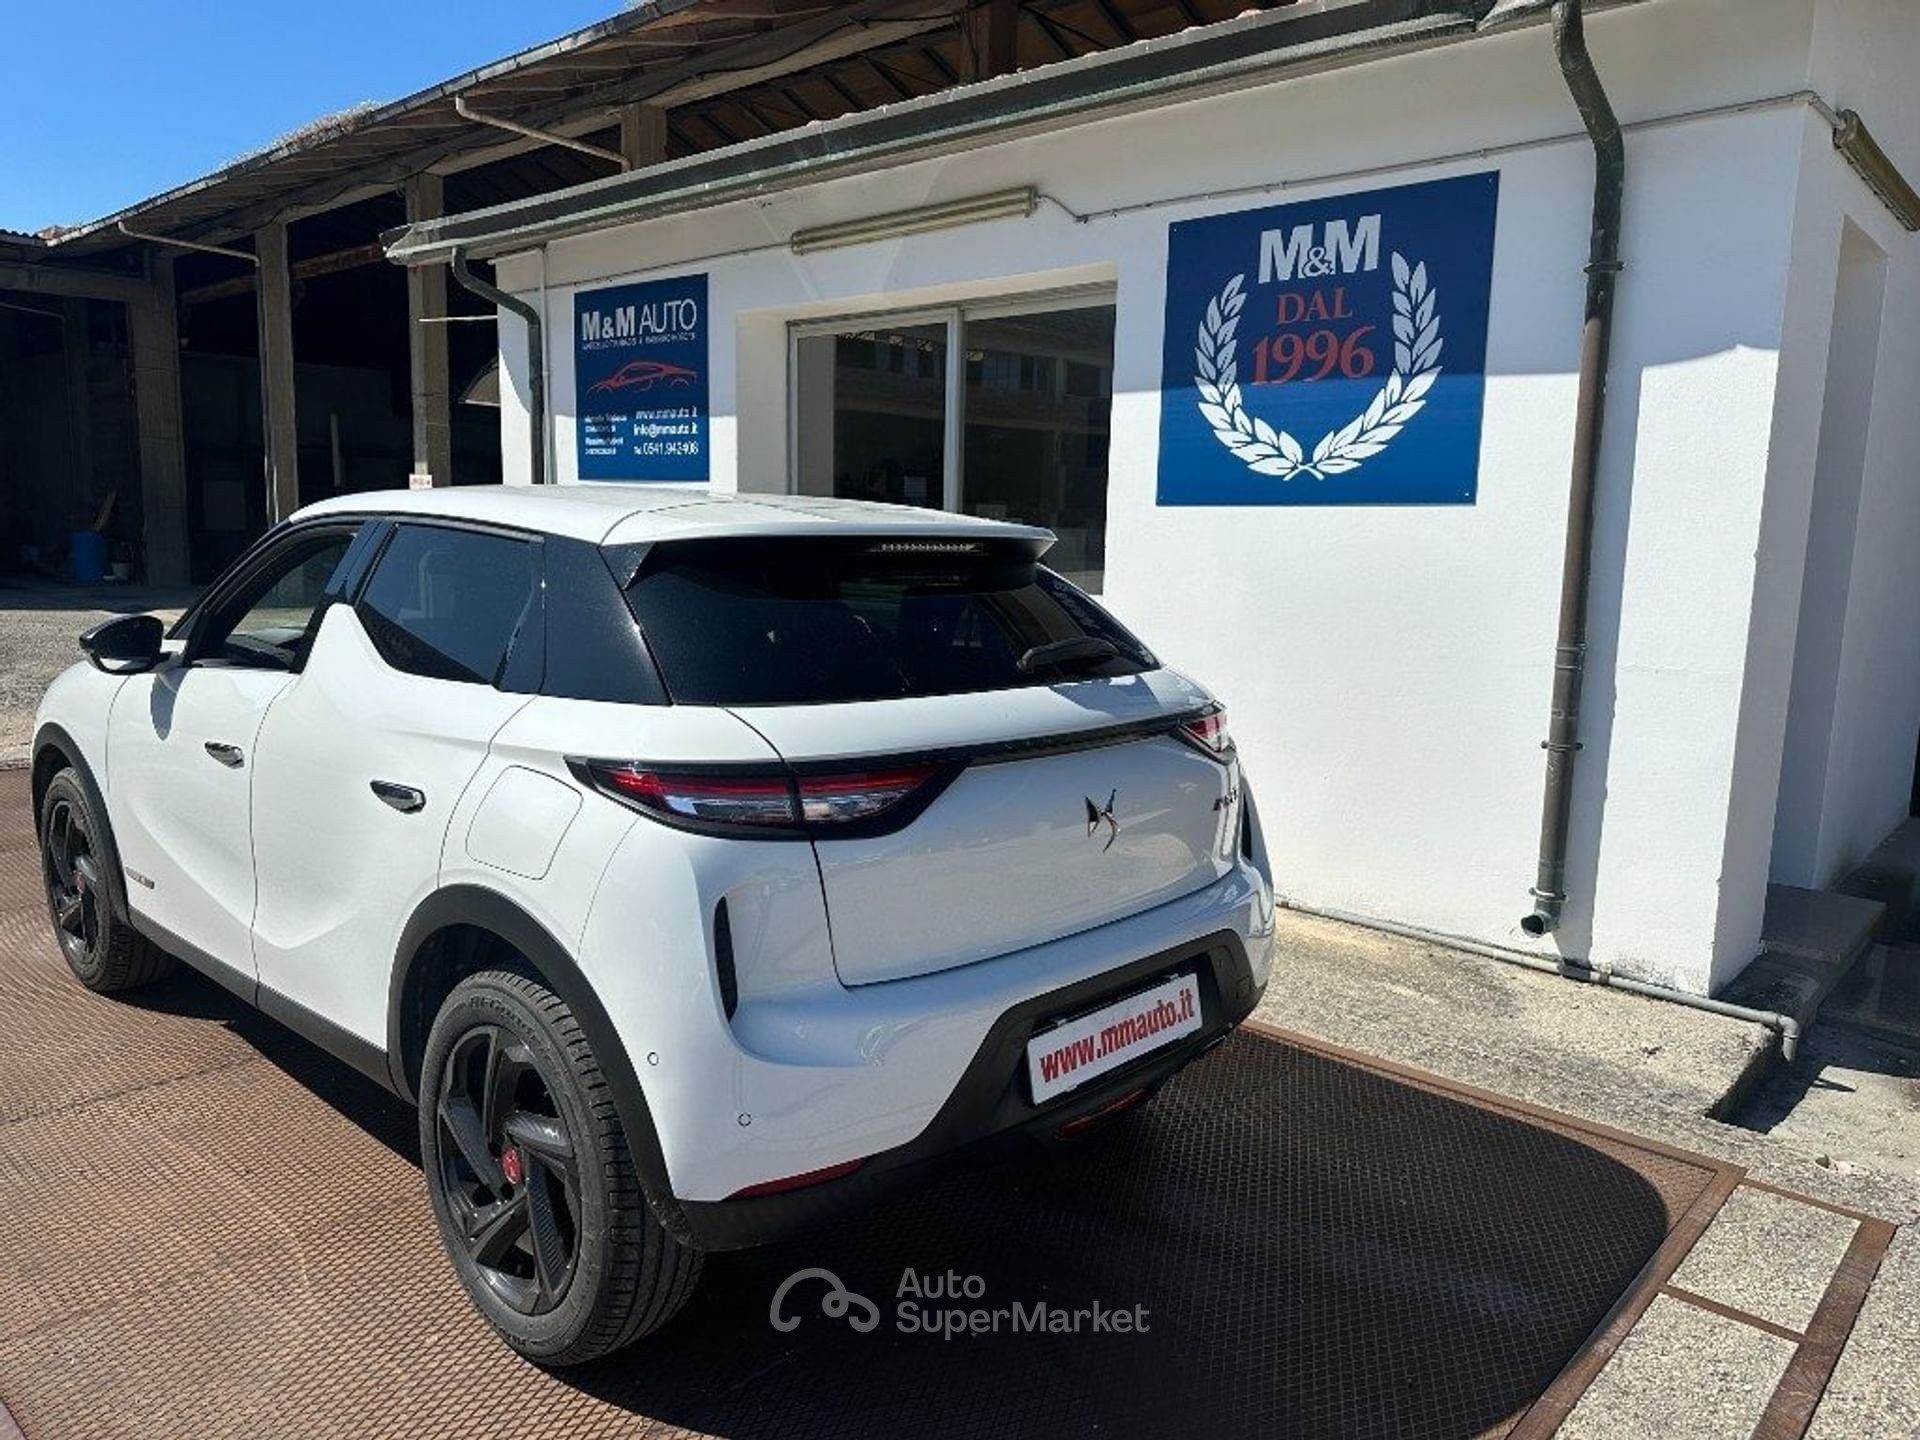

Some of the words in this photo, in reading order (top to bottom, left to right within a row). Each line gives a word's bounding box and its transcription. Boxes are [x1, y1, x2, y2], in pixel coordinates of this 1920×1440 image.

[1258, 213, 1382, 284] M&M
[581, 306, 636, 341] M&M
[638, 298, 697, 336] AUTO
[1276, 286, 1353, 324] DAL
[1250, 325, 1377, 386] 1996
[1039, 988, 1195, 1083] www.mmauto.it
